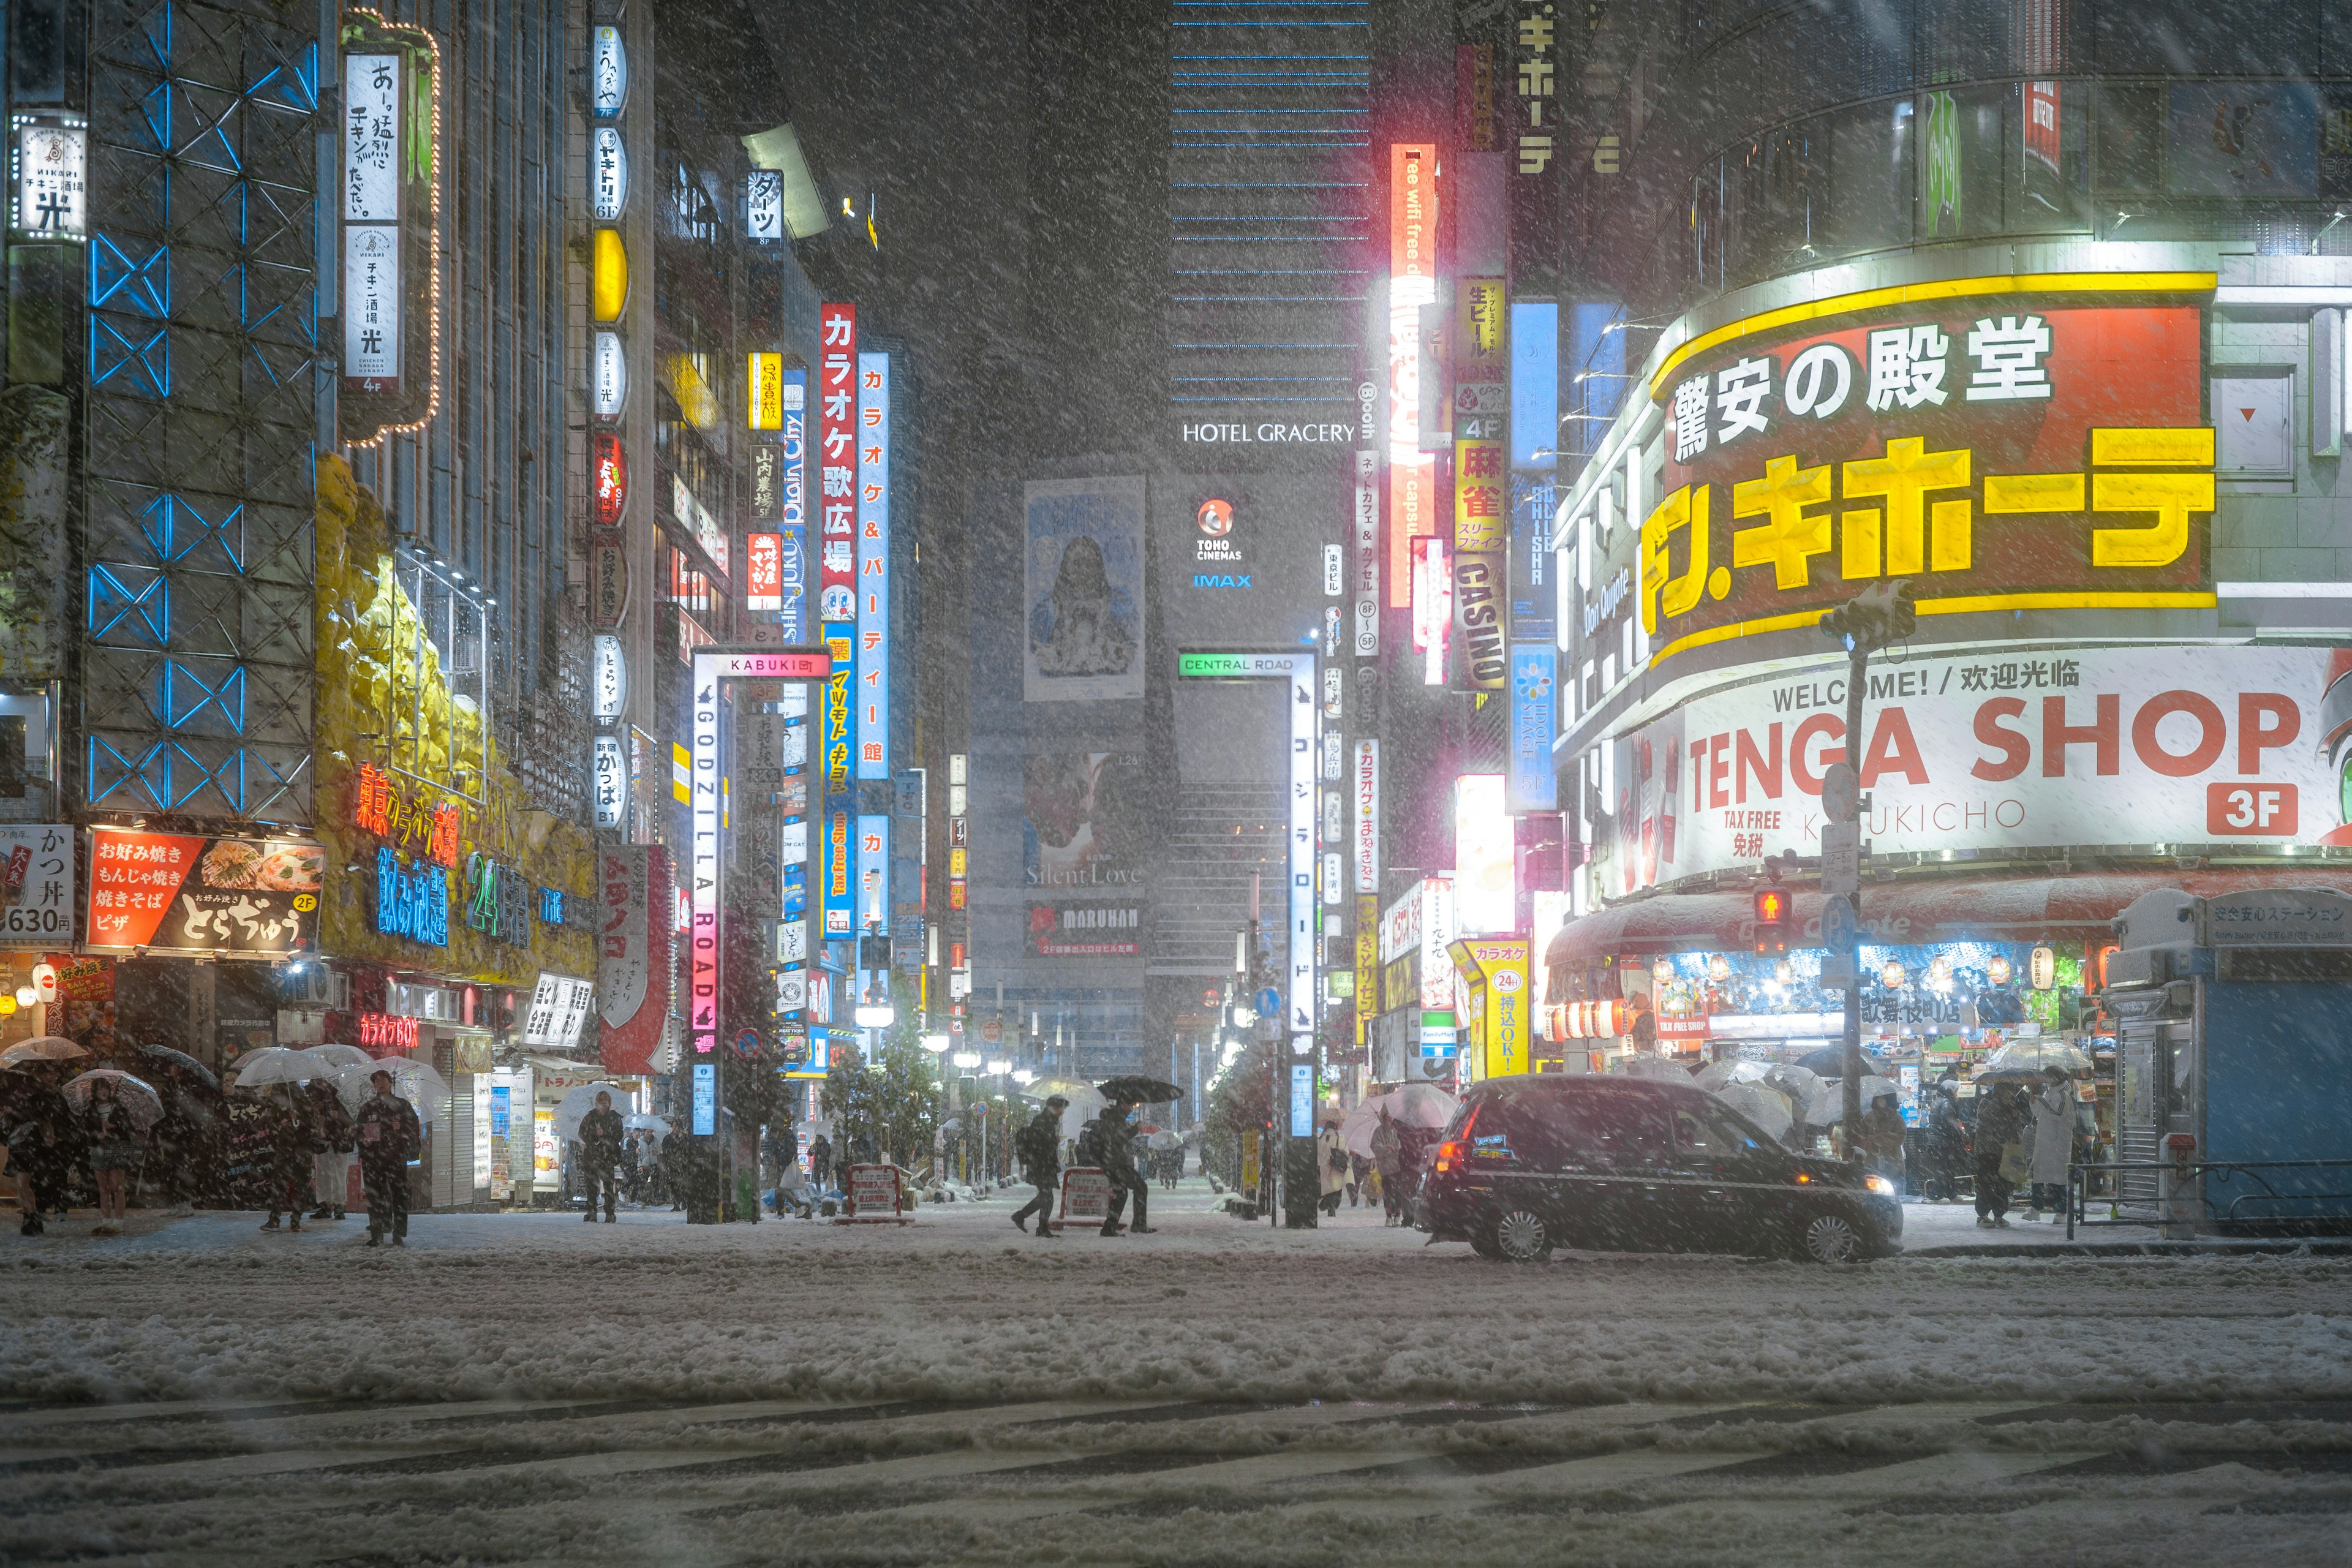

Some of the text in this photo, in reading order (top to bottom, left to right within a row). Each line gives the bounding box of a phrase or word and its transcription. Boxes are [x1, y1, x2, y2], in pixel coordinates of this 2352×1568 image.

[599, 108, 612, 118] 7F
[26, 178, 83, 192] チキン酒場
[36, 192, 71, 231] 光
[596, 206, 617, 218] 6F
[754, 175, 775, 232] ダーツ
[1406, 189, 1422, 219] wifi
[1406, 222, 1422, 260] free
[366, 262, 377, 325] チキン酒場
[1469, 285, 1487, 358] 生ビール
[361, 329, 382, 354] 光
[363, 377, 381, 392] 4F
[600, 389, 612, 402] 光
[1675, 315, 2051, 464] 驚安の殿堂
[1357, 381, 1378, 440] Booth
[783, 415, 804, 461] City
[824, 314, 853, 573] カラオケ歌広場
[1183, 423, 1355, 442] HOTEL GRACERY
[1466, 420, 1498, 439] 4F
[755, 448, 774, 507] 山内農場
[1463, 445, 1501, 518] 麻雀
[1362, 458, 1373, 592] ネットカフェ & カプセル
[1458, 523, 1494, 535] スリー
[1197, 540, 1229, 551] TOHO
[1197, 551, 1242, 560] CINEMAS
[864, 371, 883, 761] カラオケ&パーティー館
[1329, 554, 1338, 592] 東京ビル
[783, 541, 803, 646] SHINJUKU
[1194, 575, 1253, 588] IMAX
[1584, 567, 1629, 638] Don Quijote
[1456, 562, 1505, 682] CASINO
[1185, 659, 1293, 671] CENTRAL ROAD
[1773, 669, 1928, 713] WELCME!
[1960, 658, 2080, 693] 欢迎光临
[598, 717, 614, 726] 1F
[1521, 704, 1535, 758] STAGE
[1534, 704, 1548, 748] IDOL
[596, 744, 616, 752] 新宿
[1690, 689, 2301, 813] TENGA SHOP
[597, 753, 617, 805] かっぱ
[1521, 782, 1545, 791] 5F
[598, 812, 614, 822] B1
[1360, 754, 1374, 892] カラオケ まねきねこ
[1724, 810, 1781, 829] TAX FREE
[1804, 799, 2025, 841] KUKICHO
[2225, 789, 2280, 828] 3F
[99, 842, 182, 864] お好み焼き
[696, 710, 714, 997] GODZILLA ROAD
[832, 812, 848, 896] Tax Free Shop
[1733, 832, 1763, 858] 免税
[7, 848, 28, 886] 大人気
[39, 829, 64, 907] かつ丼
[99, 866, 181, 886] もんじゃ焼き
[1027, 862, 1142, 885] Silent Love
[95, 889, 163, 908] 焼きそば
[195, 893, 239, 904] お好み焼き
[296, 896, 312, 908] 2F
[96, 914, 129, 932] ピザ
[181, 892, 300, 942] とらぢゅう
[1063, 909, 1138, 929] MARUHAN
[2215, 906, 2345, 922] 安全安心ステーション
[1431, 929, 1445, 959] 九十九
[2215, 930, 2256, 940] Safety Station
[1476, 946, 1527, 961] カラオケ
[1498, 974, 1518, 987] 24H
[1859, 995, 1961, 1025] 歌舞伎町店
[360, 1012, 420, 1049] カラオケBOX
[1659, 1022, 1673, 1032] TAX
[1688, 1021, 1706, 1032] SHOP
